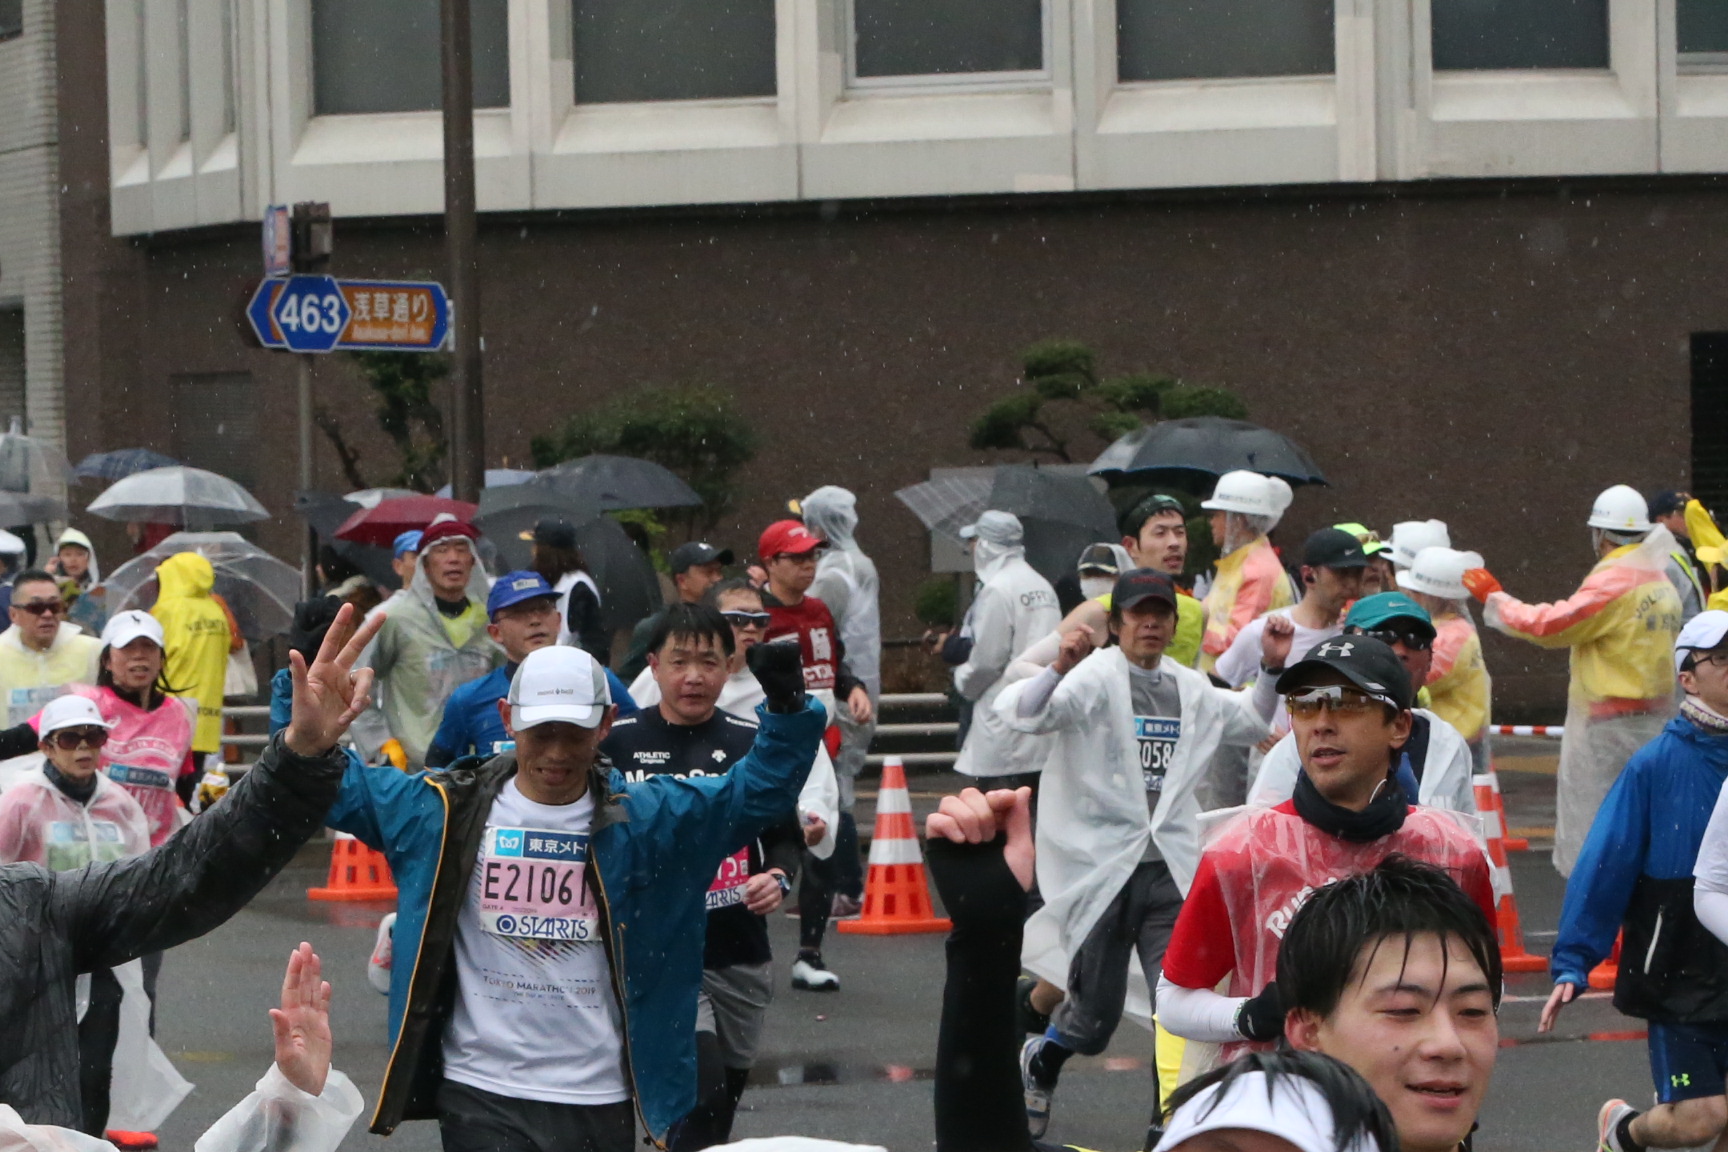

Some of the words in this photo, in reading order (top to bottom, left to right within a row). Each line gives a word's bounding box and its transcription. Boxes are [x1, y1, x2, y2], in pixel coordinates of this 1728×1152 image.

[279, 292, 342, 334] 463
[353, 291, 429, 323] 浅草通り
[633, 751, 671, 760] ATHLETIC
[1139, 741, 1176, 769] 058
[528, 837, 588, 854] 東京メト
[575, 986, 597, 995] 2019
